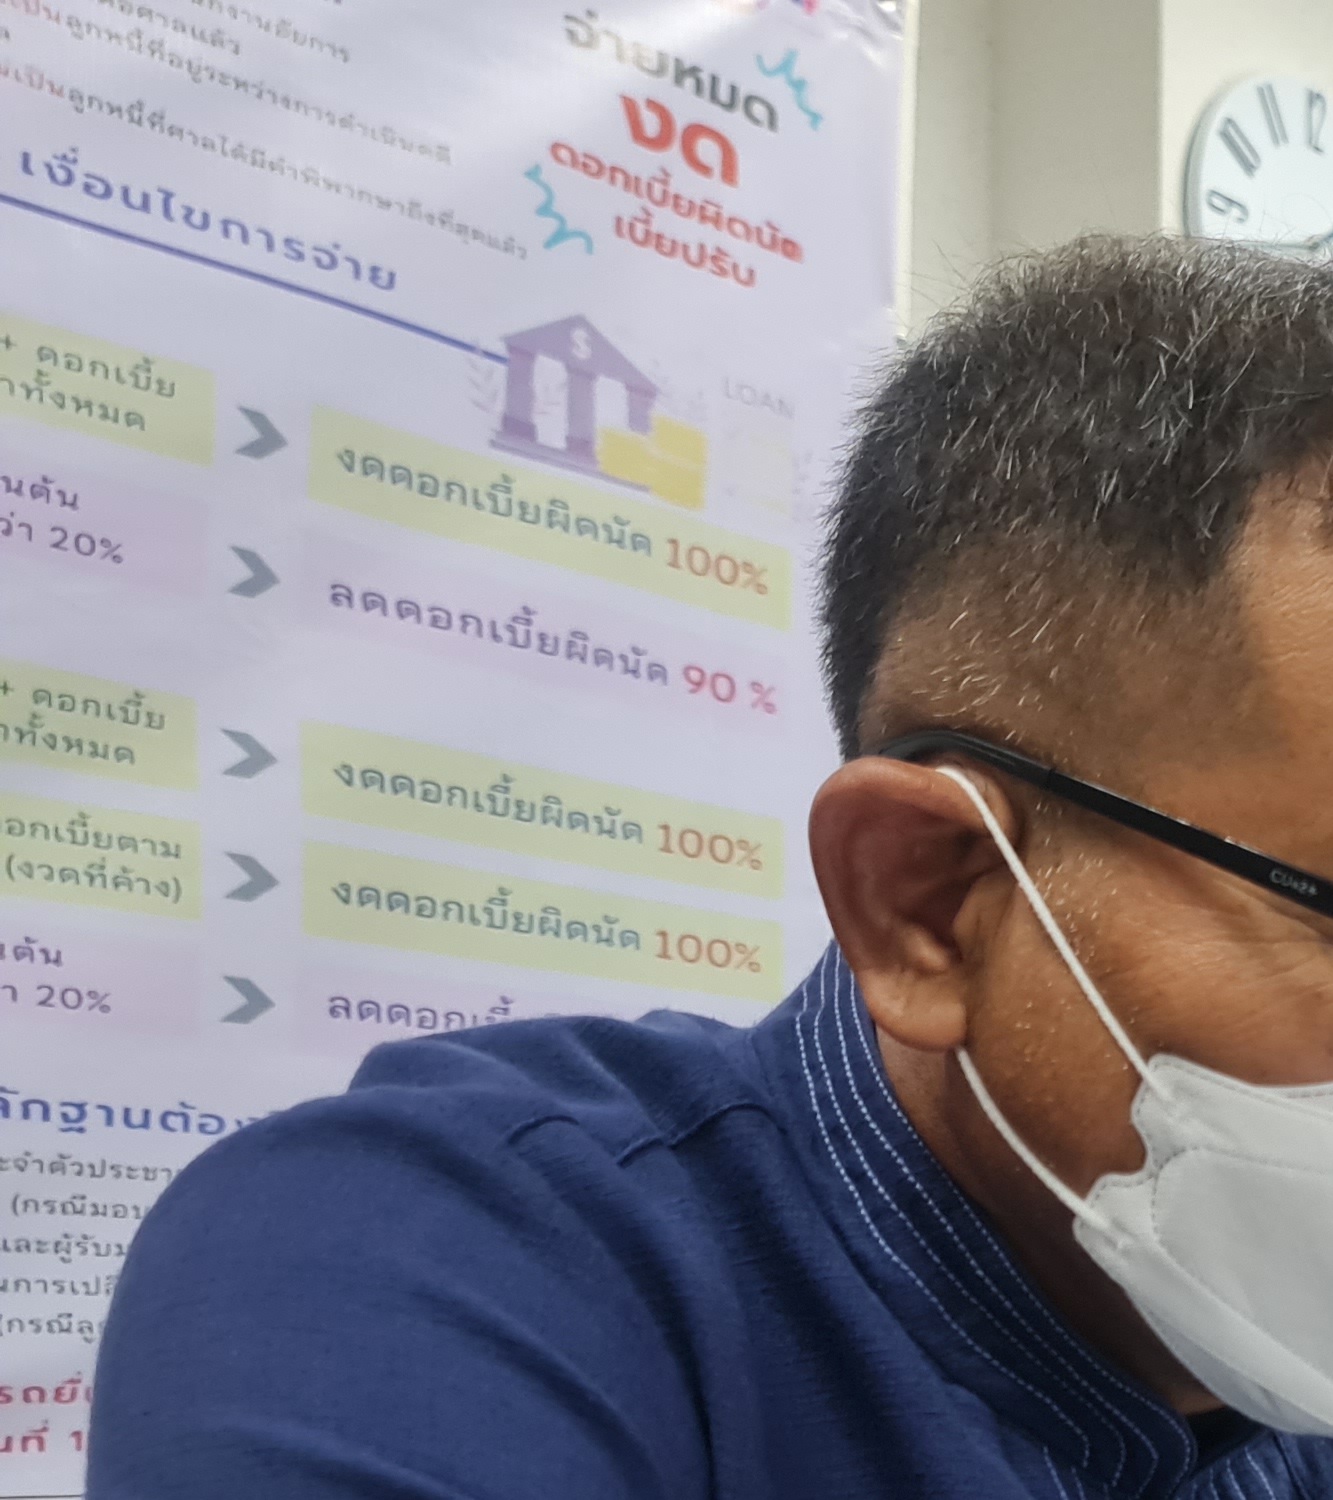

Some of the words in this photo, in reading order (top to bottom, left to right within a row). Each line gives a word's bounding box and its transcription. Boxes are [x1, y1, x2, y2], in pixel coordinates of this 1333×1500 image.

[563, 8, 779, 133] จ่ายหมด
[618, 92, 740, 189] งด
[19, 145, 399, 292] เงื่อนไขการจ่าย
[549, 140, 804, 264] ดอกเบี้ยผิดนัด
[613, 205, 758, 288] เบี้ยปรับ
[37, 344, 177, 400] ดอกเบี้ย
[50, 526, 124, 565] 20%
[335, 447, 654, 557] งดดอกเบี้ยผิดนัด
[664, 536, 770, 596] 100%
[328, 581, 670, 688] ลดดอกเบี้ยผิดนัด
[682, 664, 737, 704] 90
[32, 687, 166, 731] ดอกเบี้ย
[0, 811, 182, 861] อกเบี้ยตาม
[333, 762, 644, 844] งดดอกเบี้ยผิดนัด
[657, 822, 764, 872] 100%
[6, 853, 183, 904] (งวดที่ค้าง)
[331, 880, 642, 951] งดดอกเบี้ยผิดนัด
[655, 928, 762, 974] 100%
[36, 984, 112, 1014] 20%
